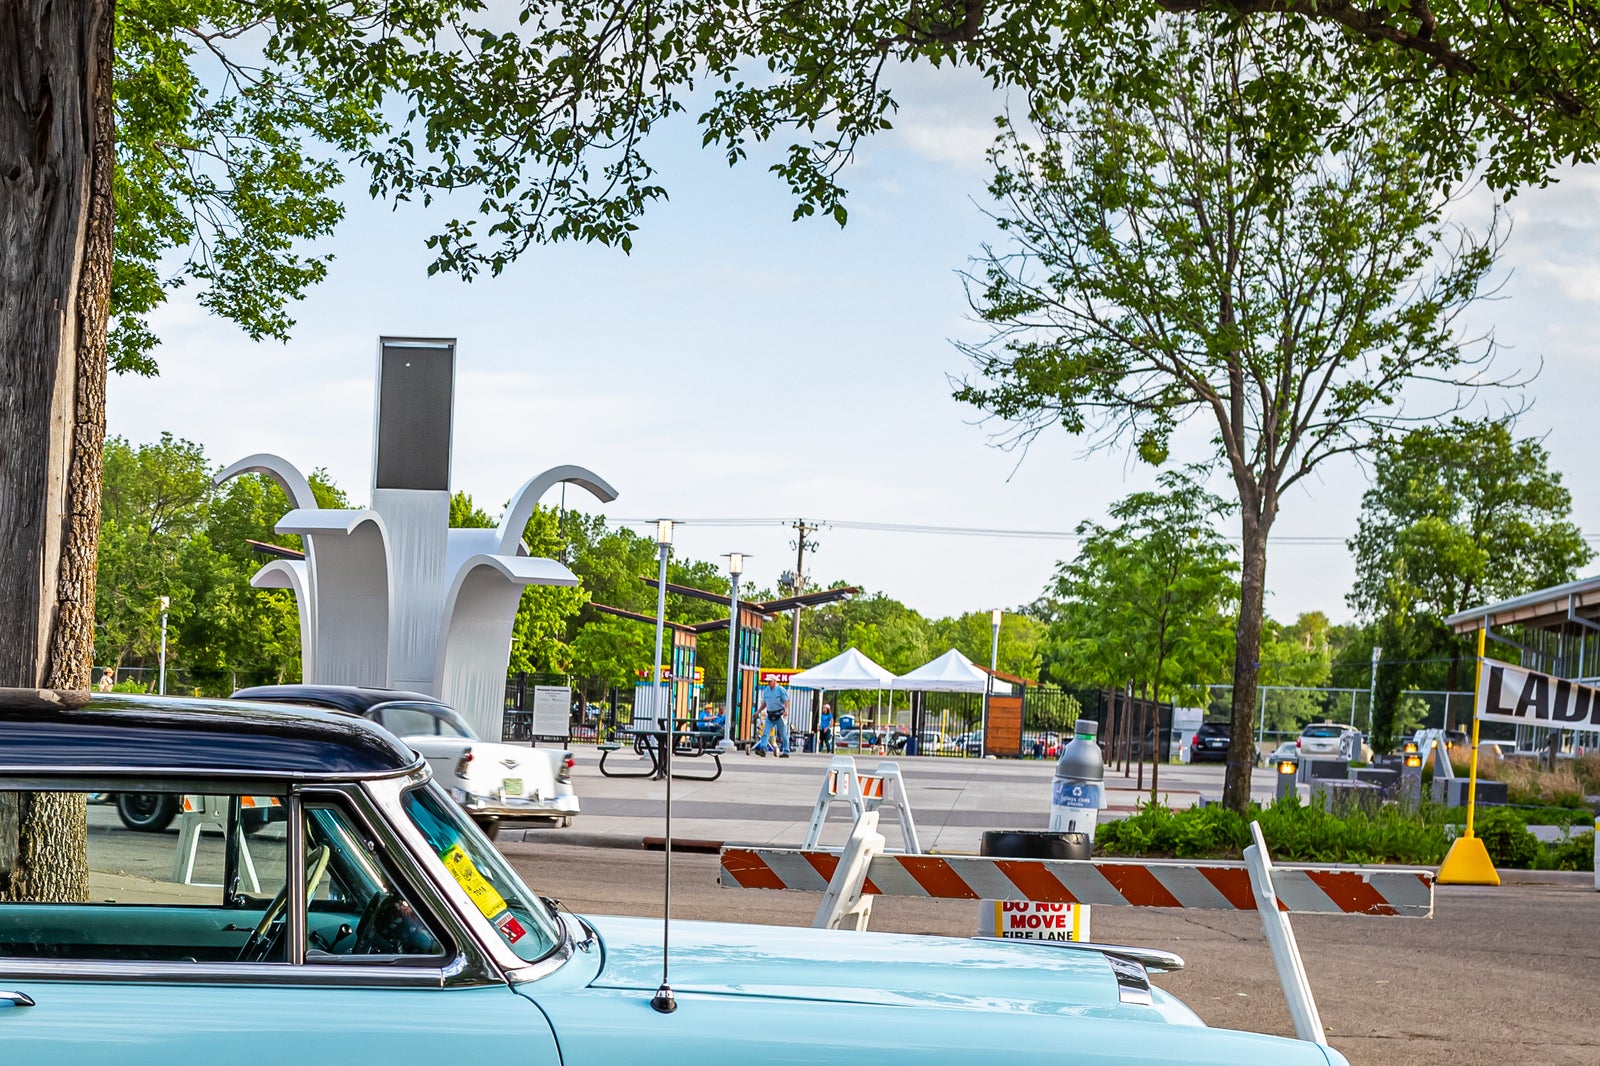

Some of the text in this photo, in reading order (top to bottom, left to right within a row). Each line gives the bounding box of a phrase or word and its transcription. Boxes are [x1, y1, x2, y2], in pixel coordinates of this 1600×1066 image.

[1485, 665, 1600, 725] LAD
[1002, 901, 1029, 912] DO
[1010, 914, 1066, 929] MOVE
[1003, 931, 1073, 941] FIRE LANE
